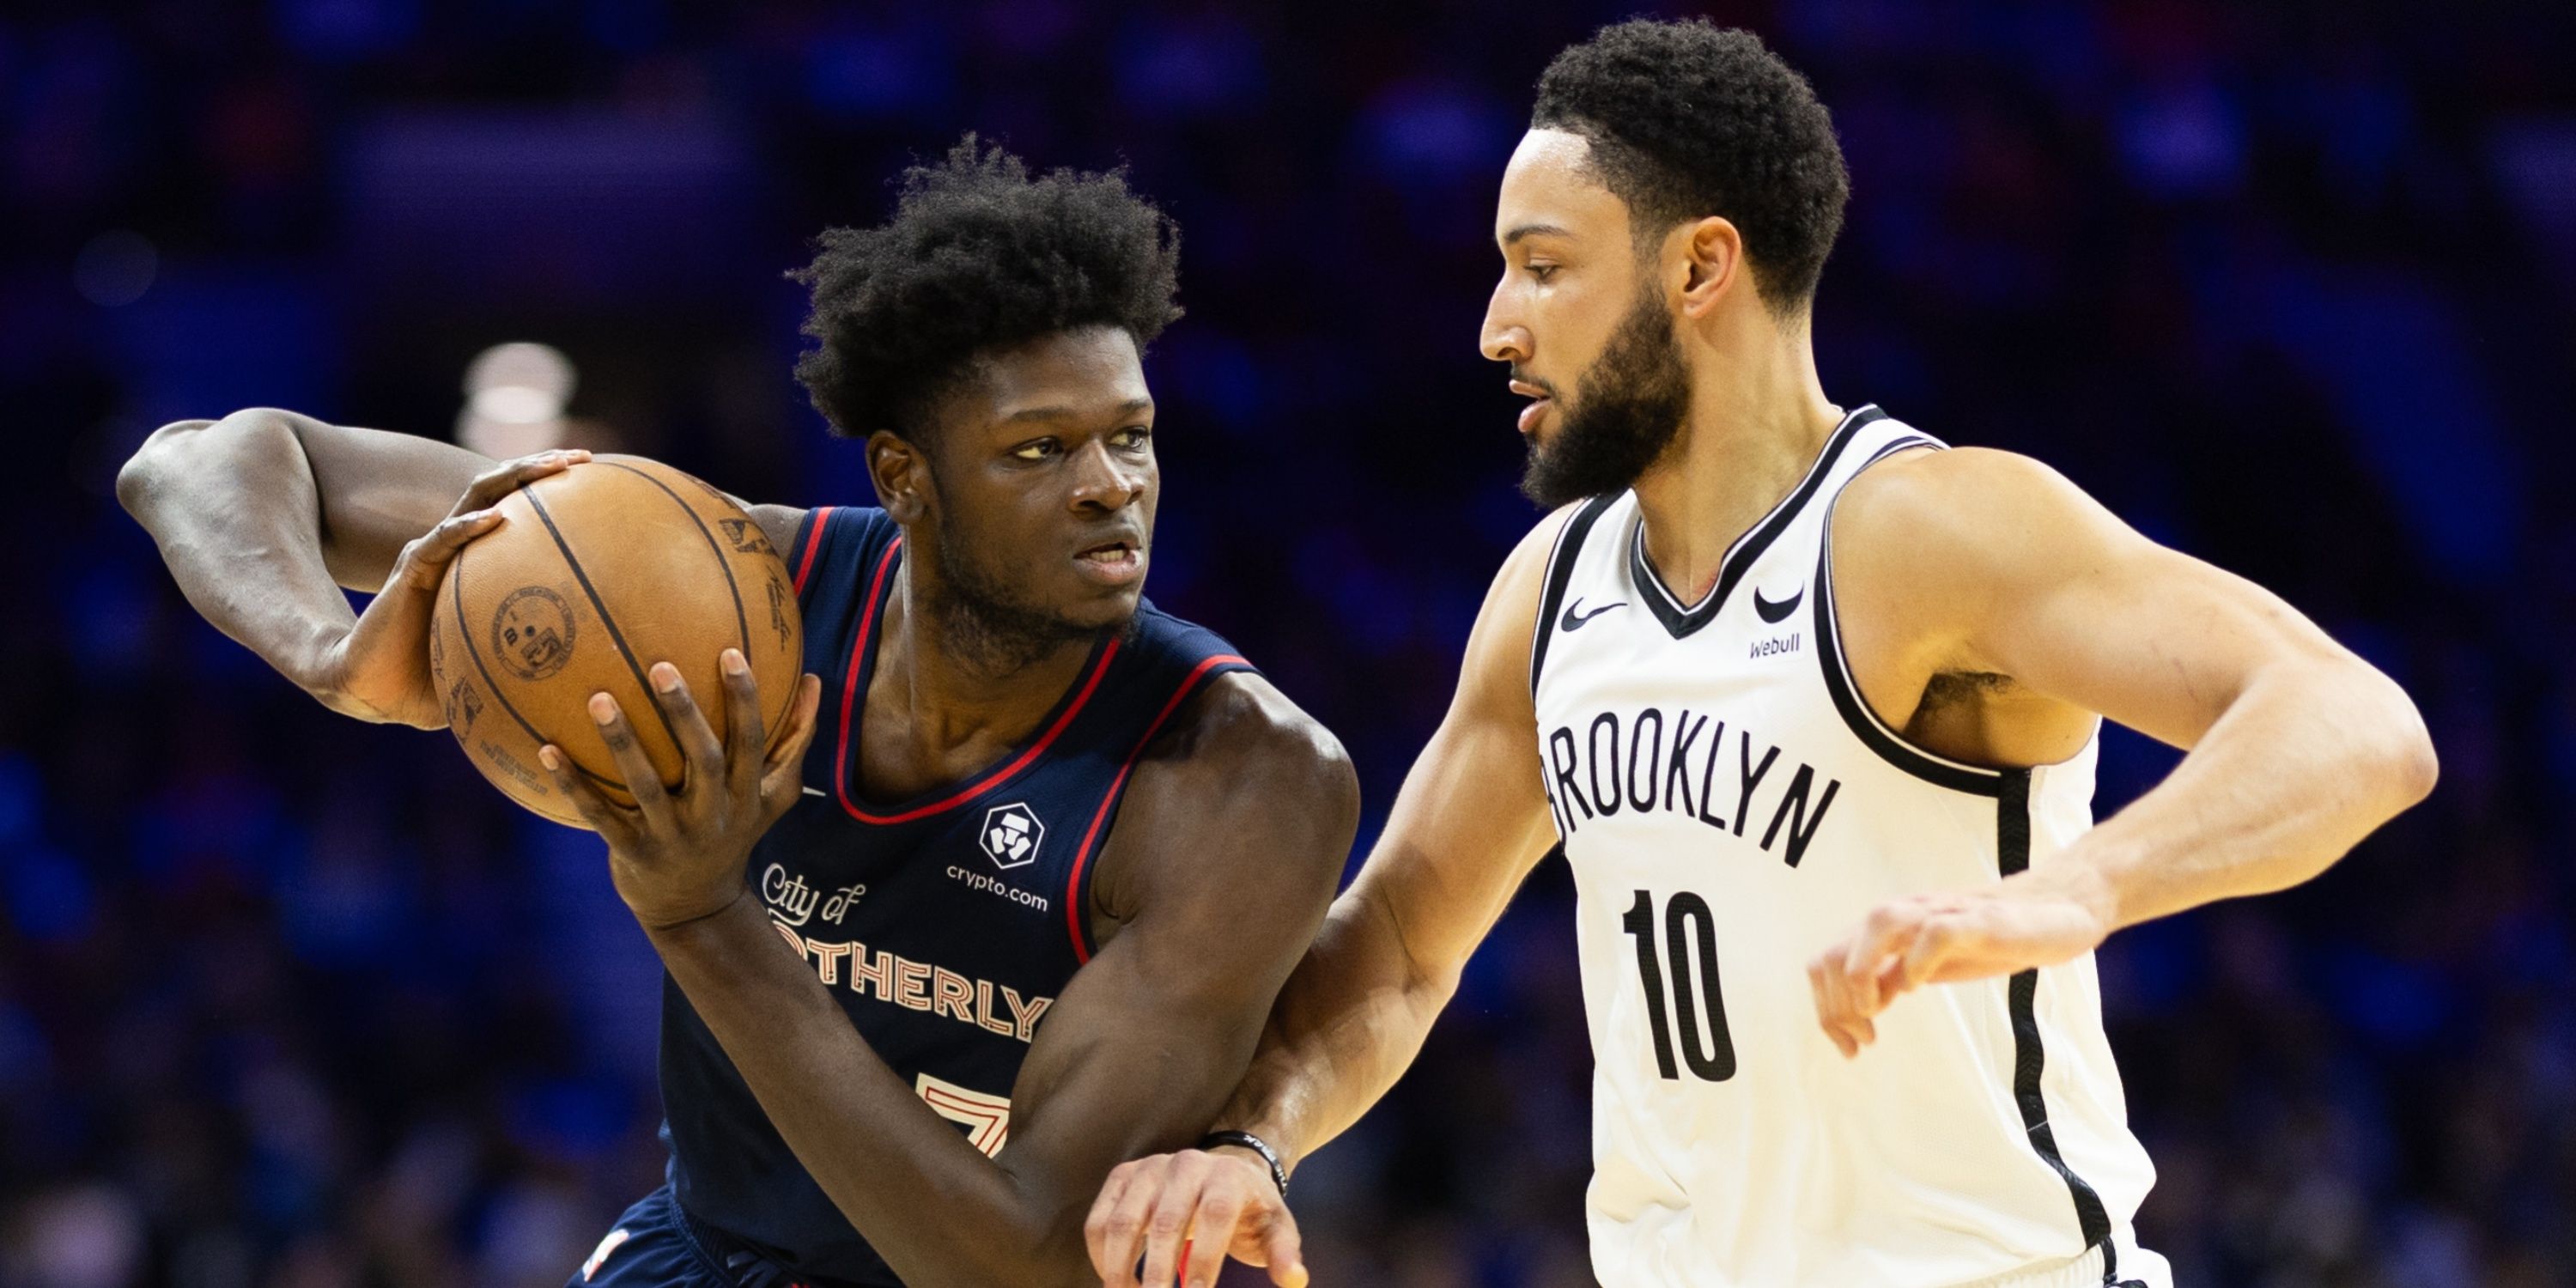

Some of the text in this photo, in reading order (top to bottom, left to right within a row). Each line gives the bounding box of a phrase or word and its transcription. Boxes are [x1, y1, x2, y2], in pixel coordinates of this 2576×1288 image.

[1749, 632, 1801, 659] Webull
[762, 862, 866, 927] City of
[946, 864, 1048, 913] crypto.com
[772, 920, 1054, 1043] THERLY
[1622, 890, 1738, 1082] 10
